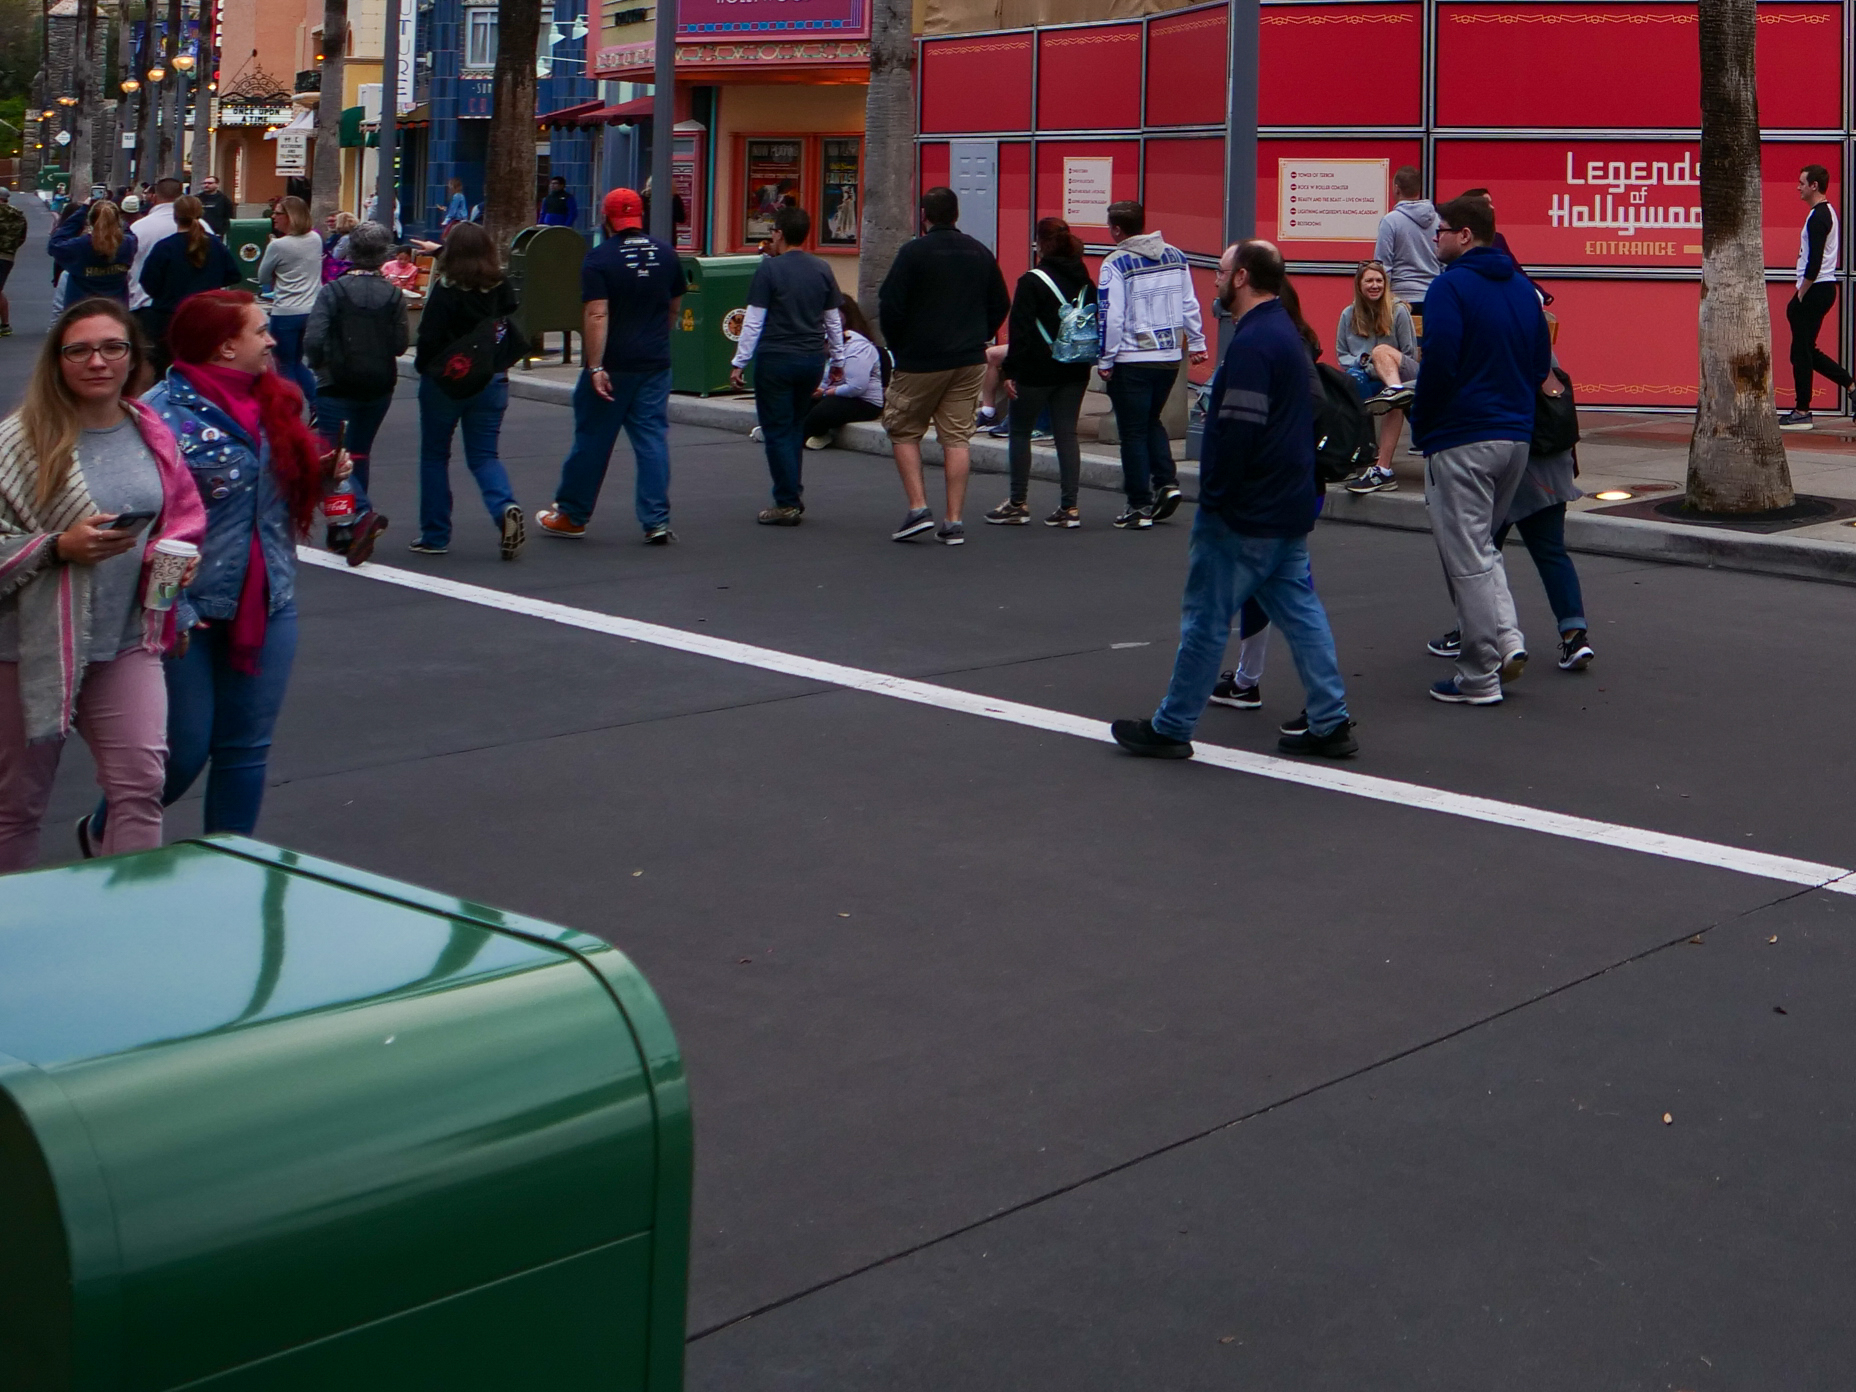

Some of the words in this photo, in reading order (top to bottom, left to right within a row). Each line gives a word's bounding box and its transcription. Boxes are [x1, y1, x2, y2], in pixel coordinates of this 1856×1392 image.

[1567, 151, 1701, 193] Legend
[1630, 187, 1648, 204] of
[1548, 194, 1702, 236] Hollywoo
[1585, 241, 1677, 256] ENTRANCE
